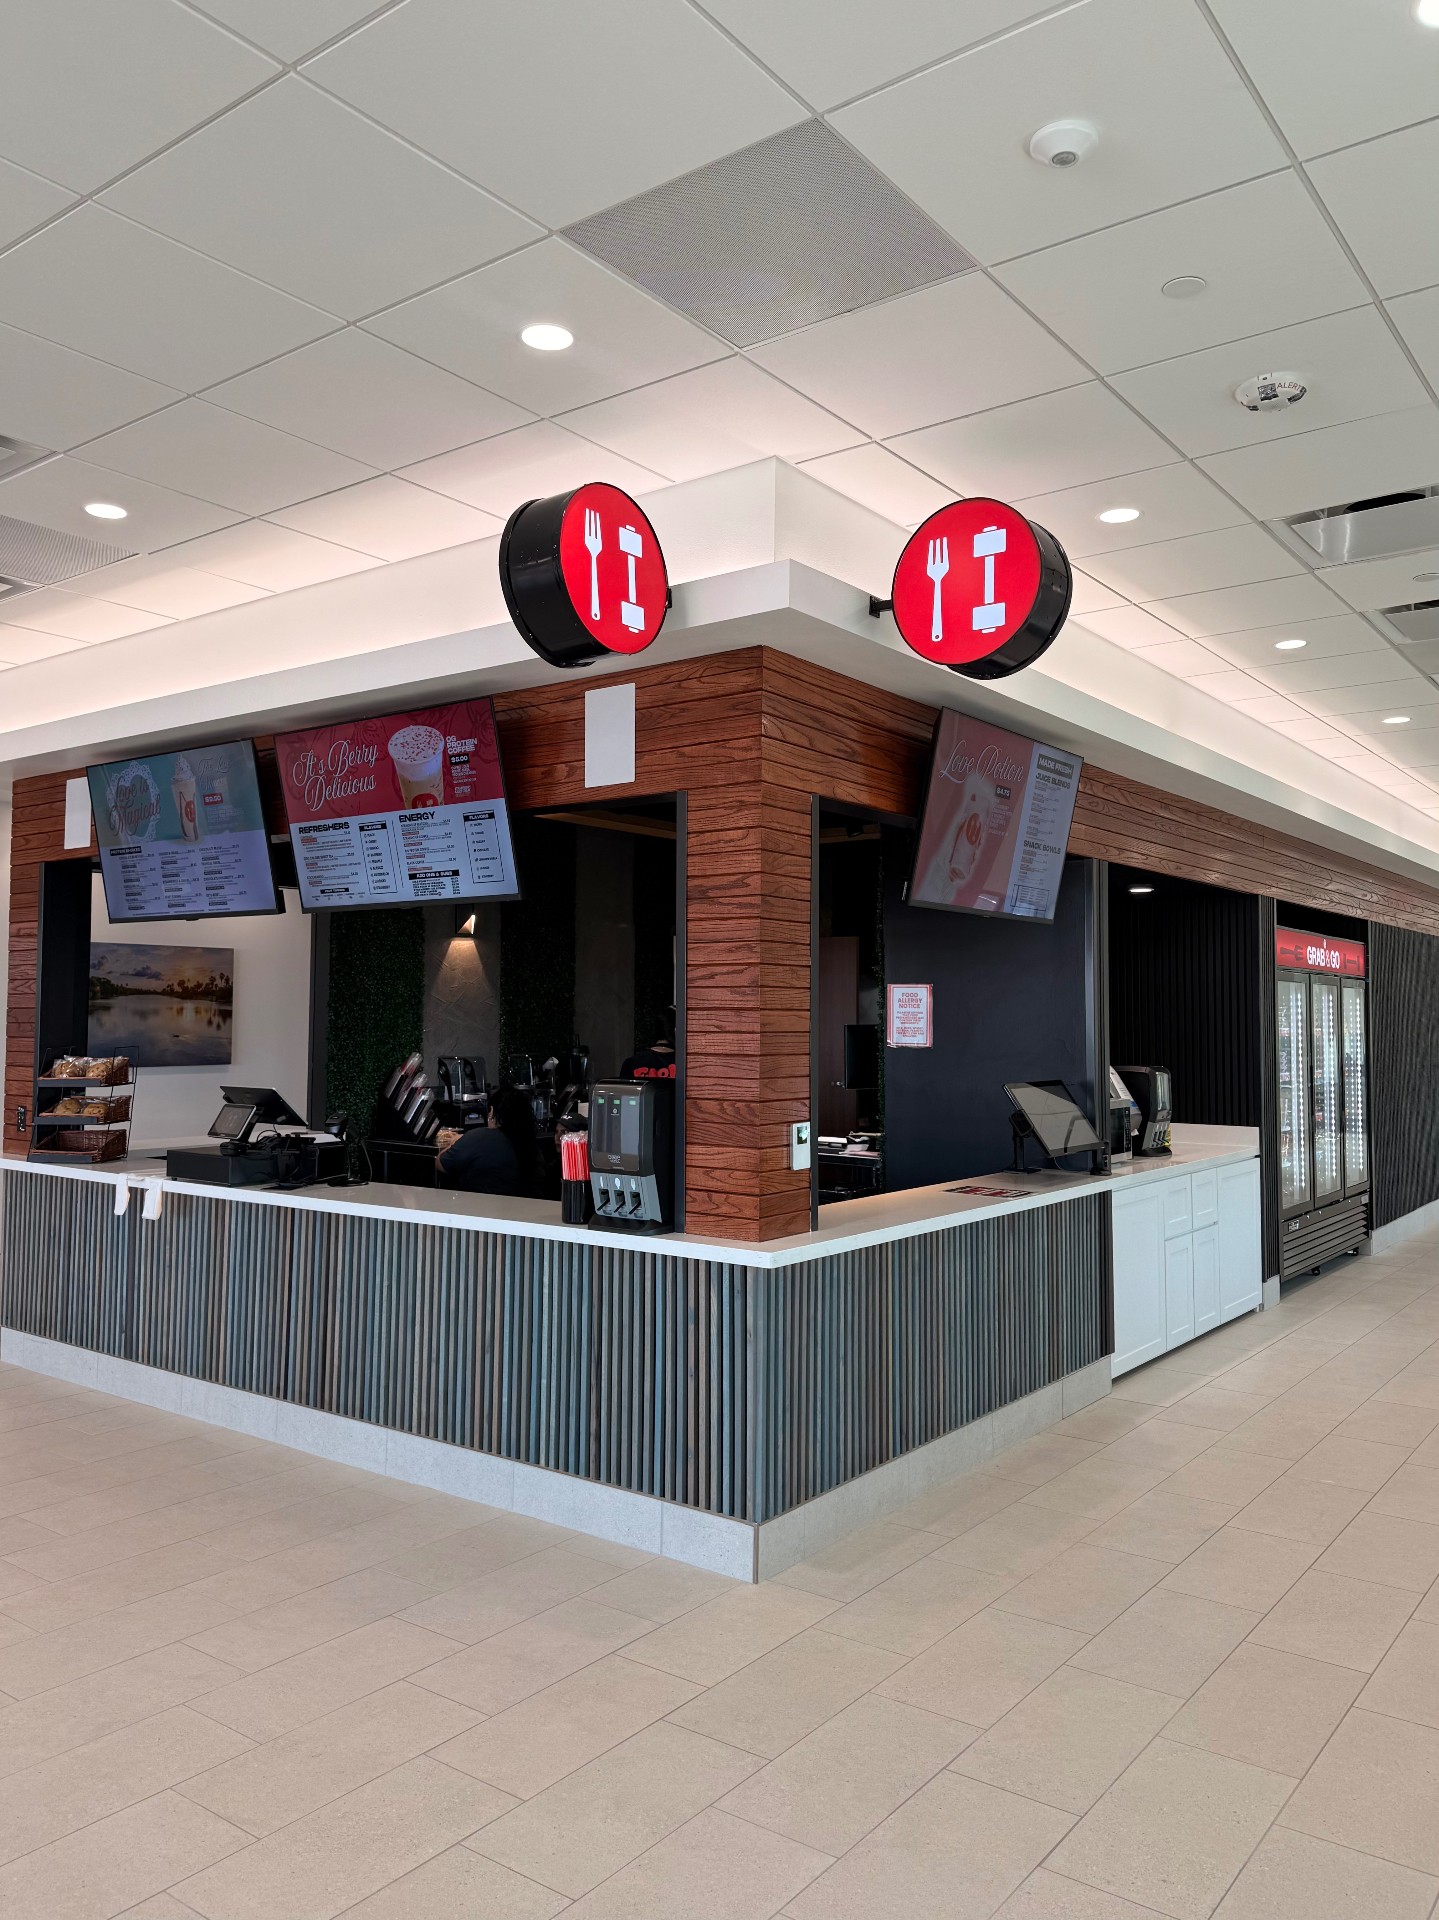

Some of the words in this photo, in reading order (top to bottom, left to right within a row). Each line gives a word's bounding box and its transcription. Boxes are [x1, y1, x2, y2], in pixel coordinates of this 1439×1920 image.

[446, 738, 477, 748] PROTEIN
[447, 744, 475, 754] COFFEE
[328, 739, 378, 777] Berry
[939, 740, 974, 784] Love
[976, 744, 1024, 783] Potion
[1038, 757, 1055, 769] MADE
[1055, 764, 1073, 775] FRESH
[1035, 772, 1051, 783] JUICE
[1051, 777, 1071, 789] BLENDS
[304, 774, 377, 812] Delicious
[109, 794, 161, 837] Magical
[399, 811, 435, 823] ENERGY
[299, 822, 350, 834] REFRESHERS
[1023, 840, 1042, 851] SNACK
[1042, 844, 1062, 855] BOWLS
[1307, 945, 1325, 967] GRAB
[1326, 950, 1330, 967] &
[1330, 950, 1340, 969] GO
